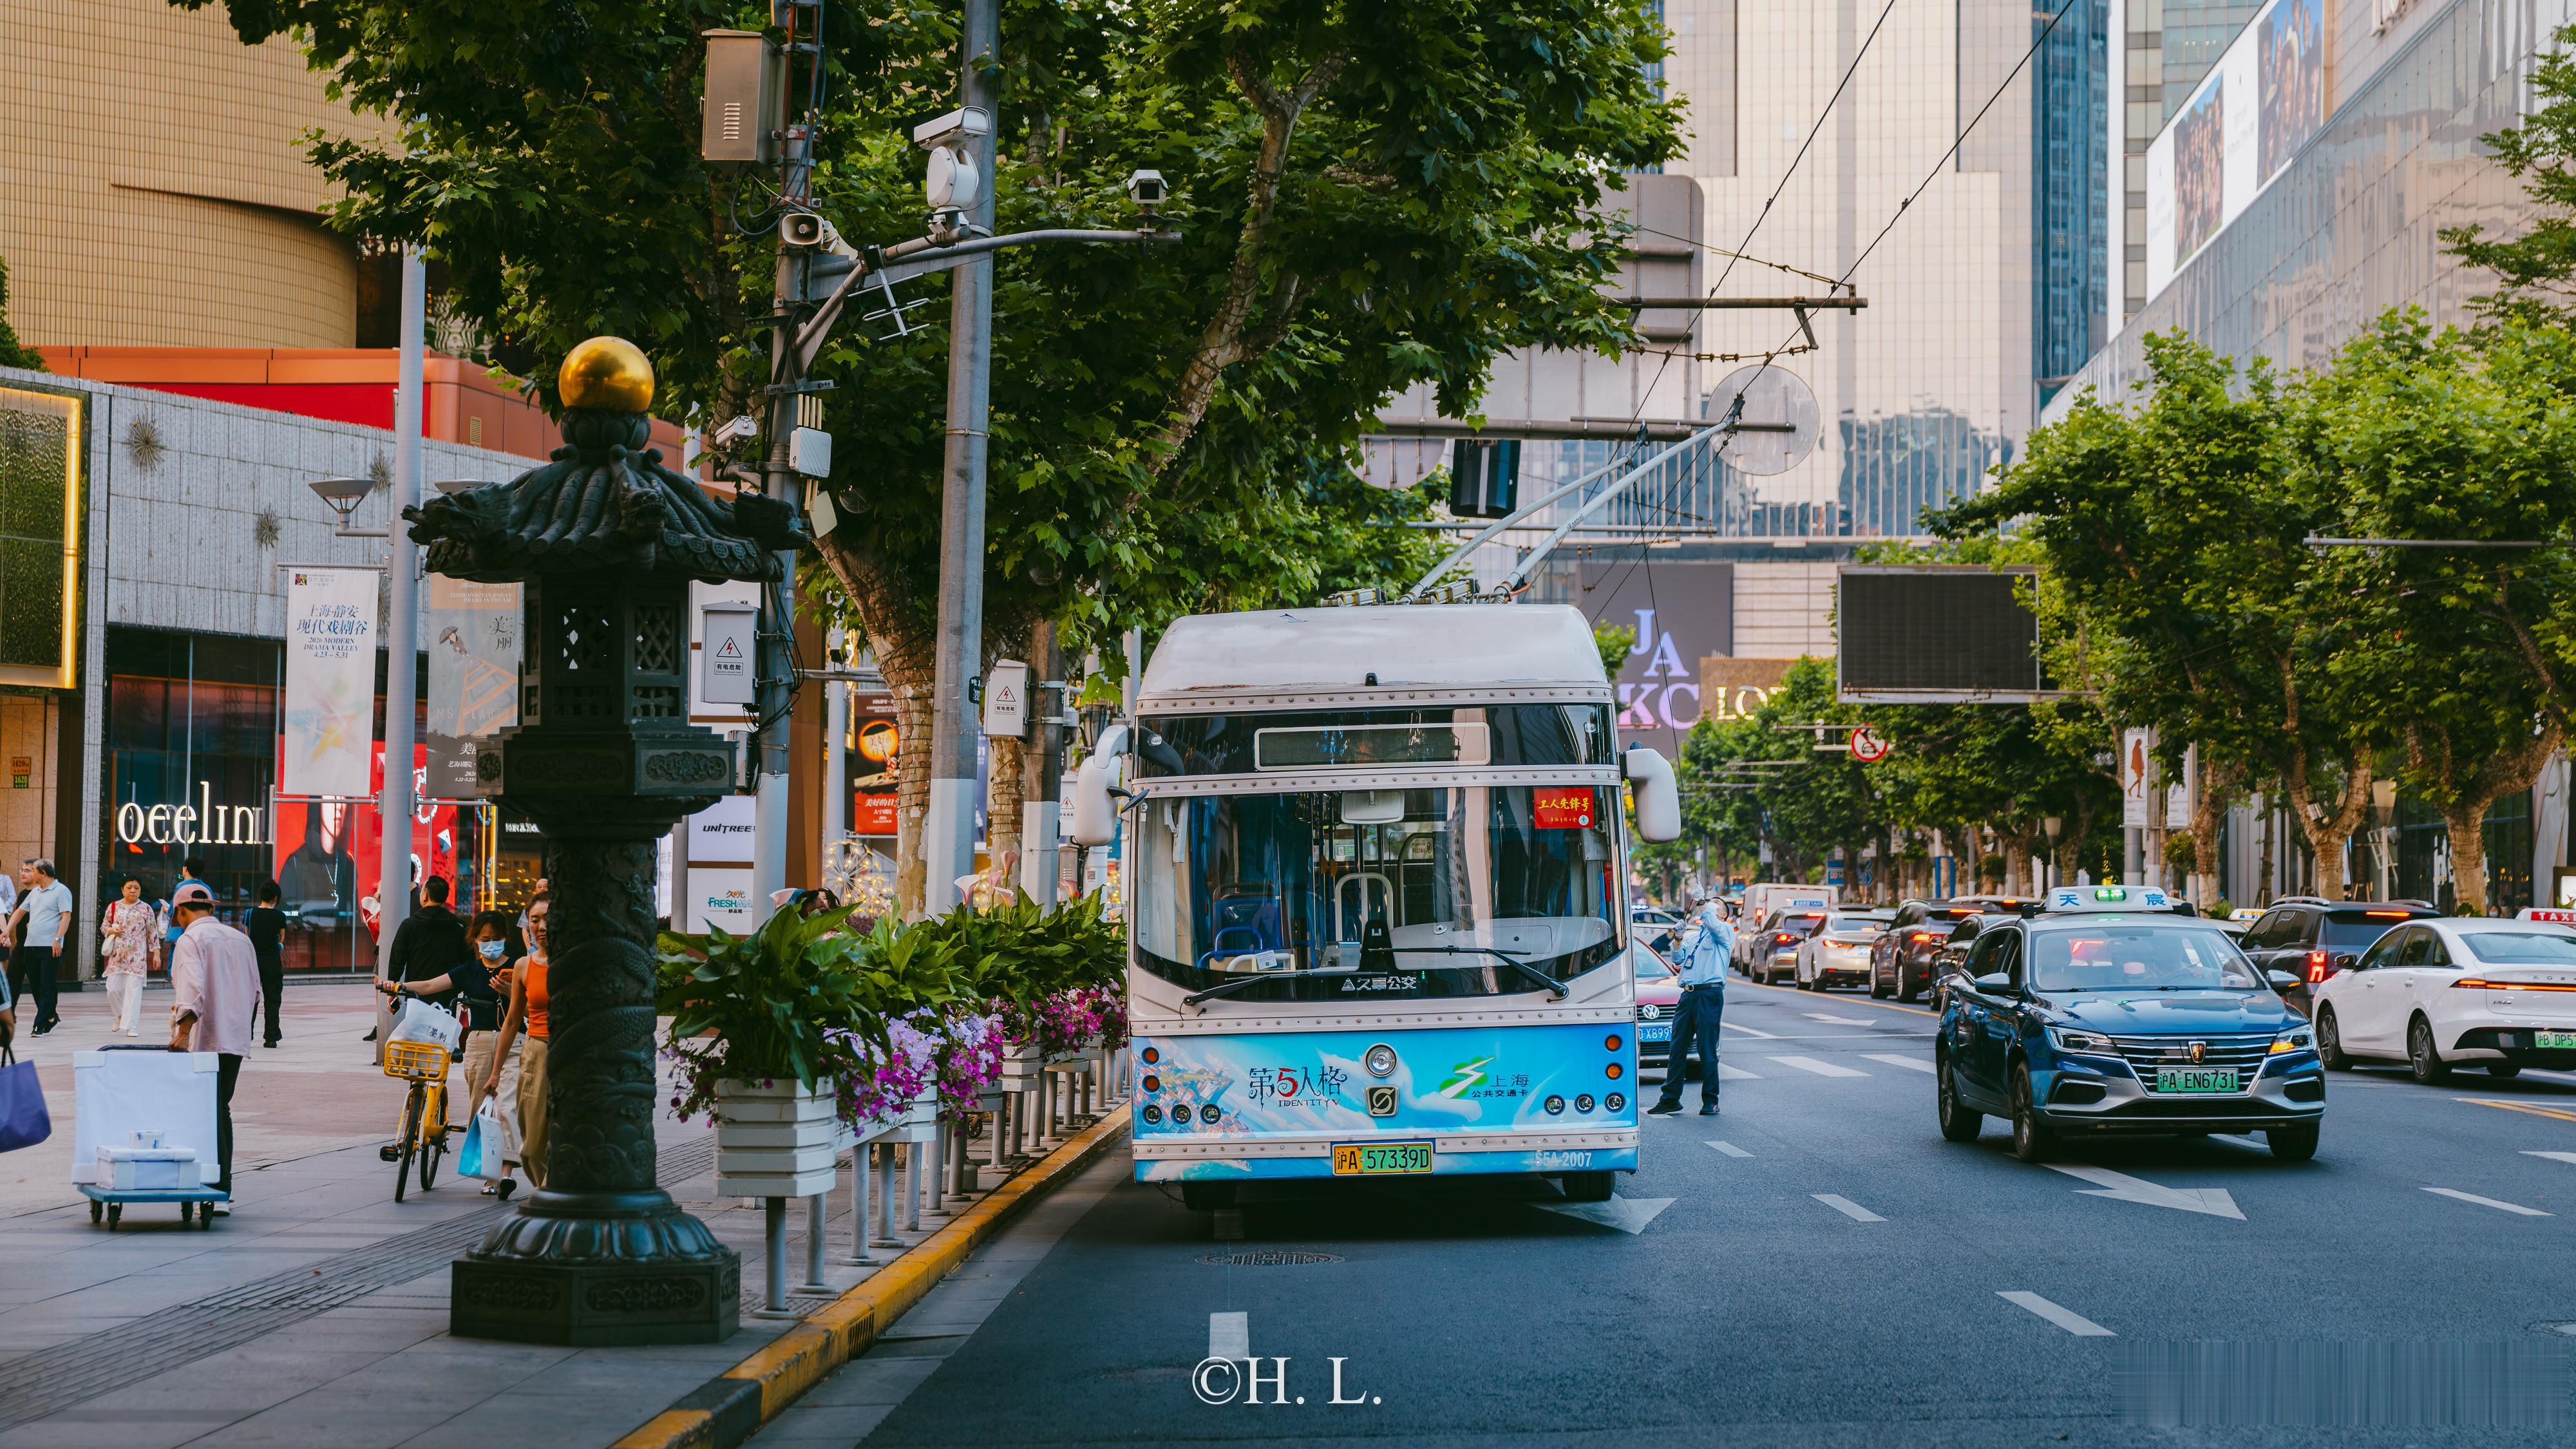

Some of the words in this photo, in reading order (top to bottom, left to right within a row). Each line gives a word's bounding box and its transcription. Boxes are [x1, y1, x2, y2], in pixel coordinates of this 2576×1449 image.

[296, 619, 368, 635] 现代戏剧谷
[15, 775, 28, 784] 1620
[1538, 797, 1589, 811] 工人先锋号
[703, 824, 752, 833] UNITREE
[726, 890, 746, 898] 久光
[2145, 893, 2166, 906] 宸
[2059, 894, 2080, 907] 天
[2555, 1034, 2576, 1046] DP5
[1490, 1074, 1530, 1087] 上海
[1249, 1066, 1348, 1111] 第5人格
[1471, 1089, 1529, 1098] 公共交通卡
[1278, 1099, 1330, 1111] IDENTITY
